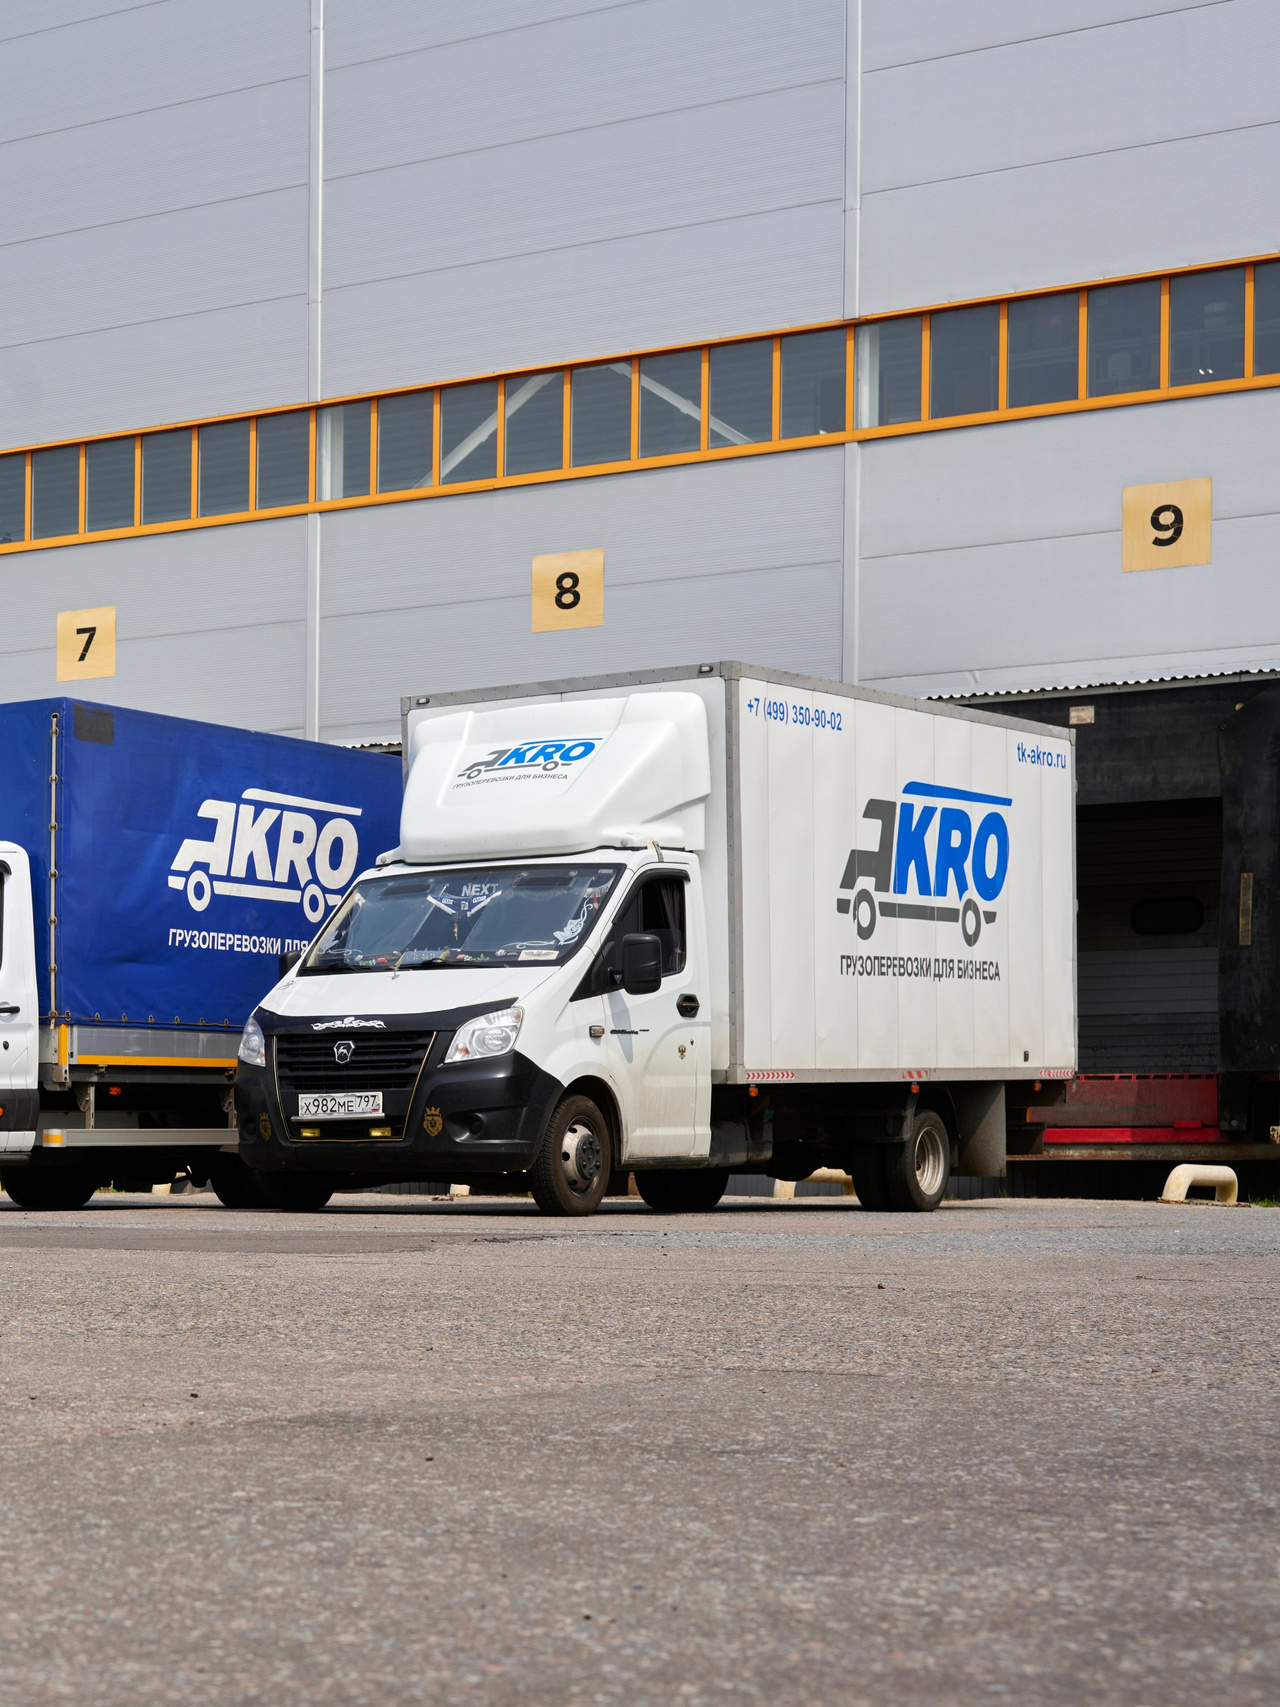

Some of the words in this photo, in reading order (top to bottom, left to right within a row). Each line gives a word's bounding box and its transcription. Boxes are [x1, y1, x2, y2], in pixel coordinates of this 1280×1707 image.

[1149, 503, 1185, 548] 9
[553, 571, 582, 611] 8
[75, 625, 97, 663] 7
[747, 697, 761, 717] +7
[763, 696, 789, 725] (499)
[792, 704, 843, 731] 350-90-02
[461, 741, 597, 773] AKRO
[1016, 742, 1067, 770] tk-akro.ru
[451, 775, 515, 790] ГРУЗОПЕРЕВОЗКИ
[532, 773, 569, 781] БИЗНЕСА
[170, 798, 360, 890] AKRO
[838, 798, 1010, 903] AKRO
[461, 883, 499, 897] NEXT
[168, 928, 282, 955] ГРУЗОПЕРЕВОЗКИ
[840, 954, 932, 978] ГРУЗОПЕРЕВОЗКИ
[933, 957, 955, 982] ДЛЯ
[957, 959, 1001, 981] БИЗНЕСА
[356, 1094, 377, 1108] 797
